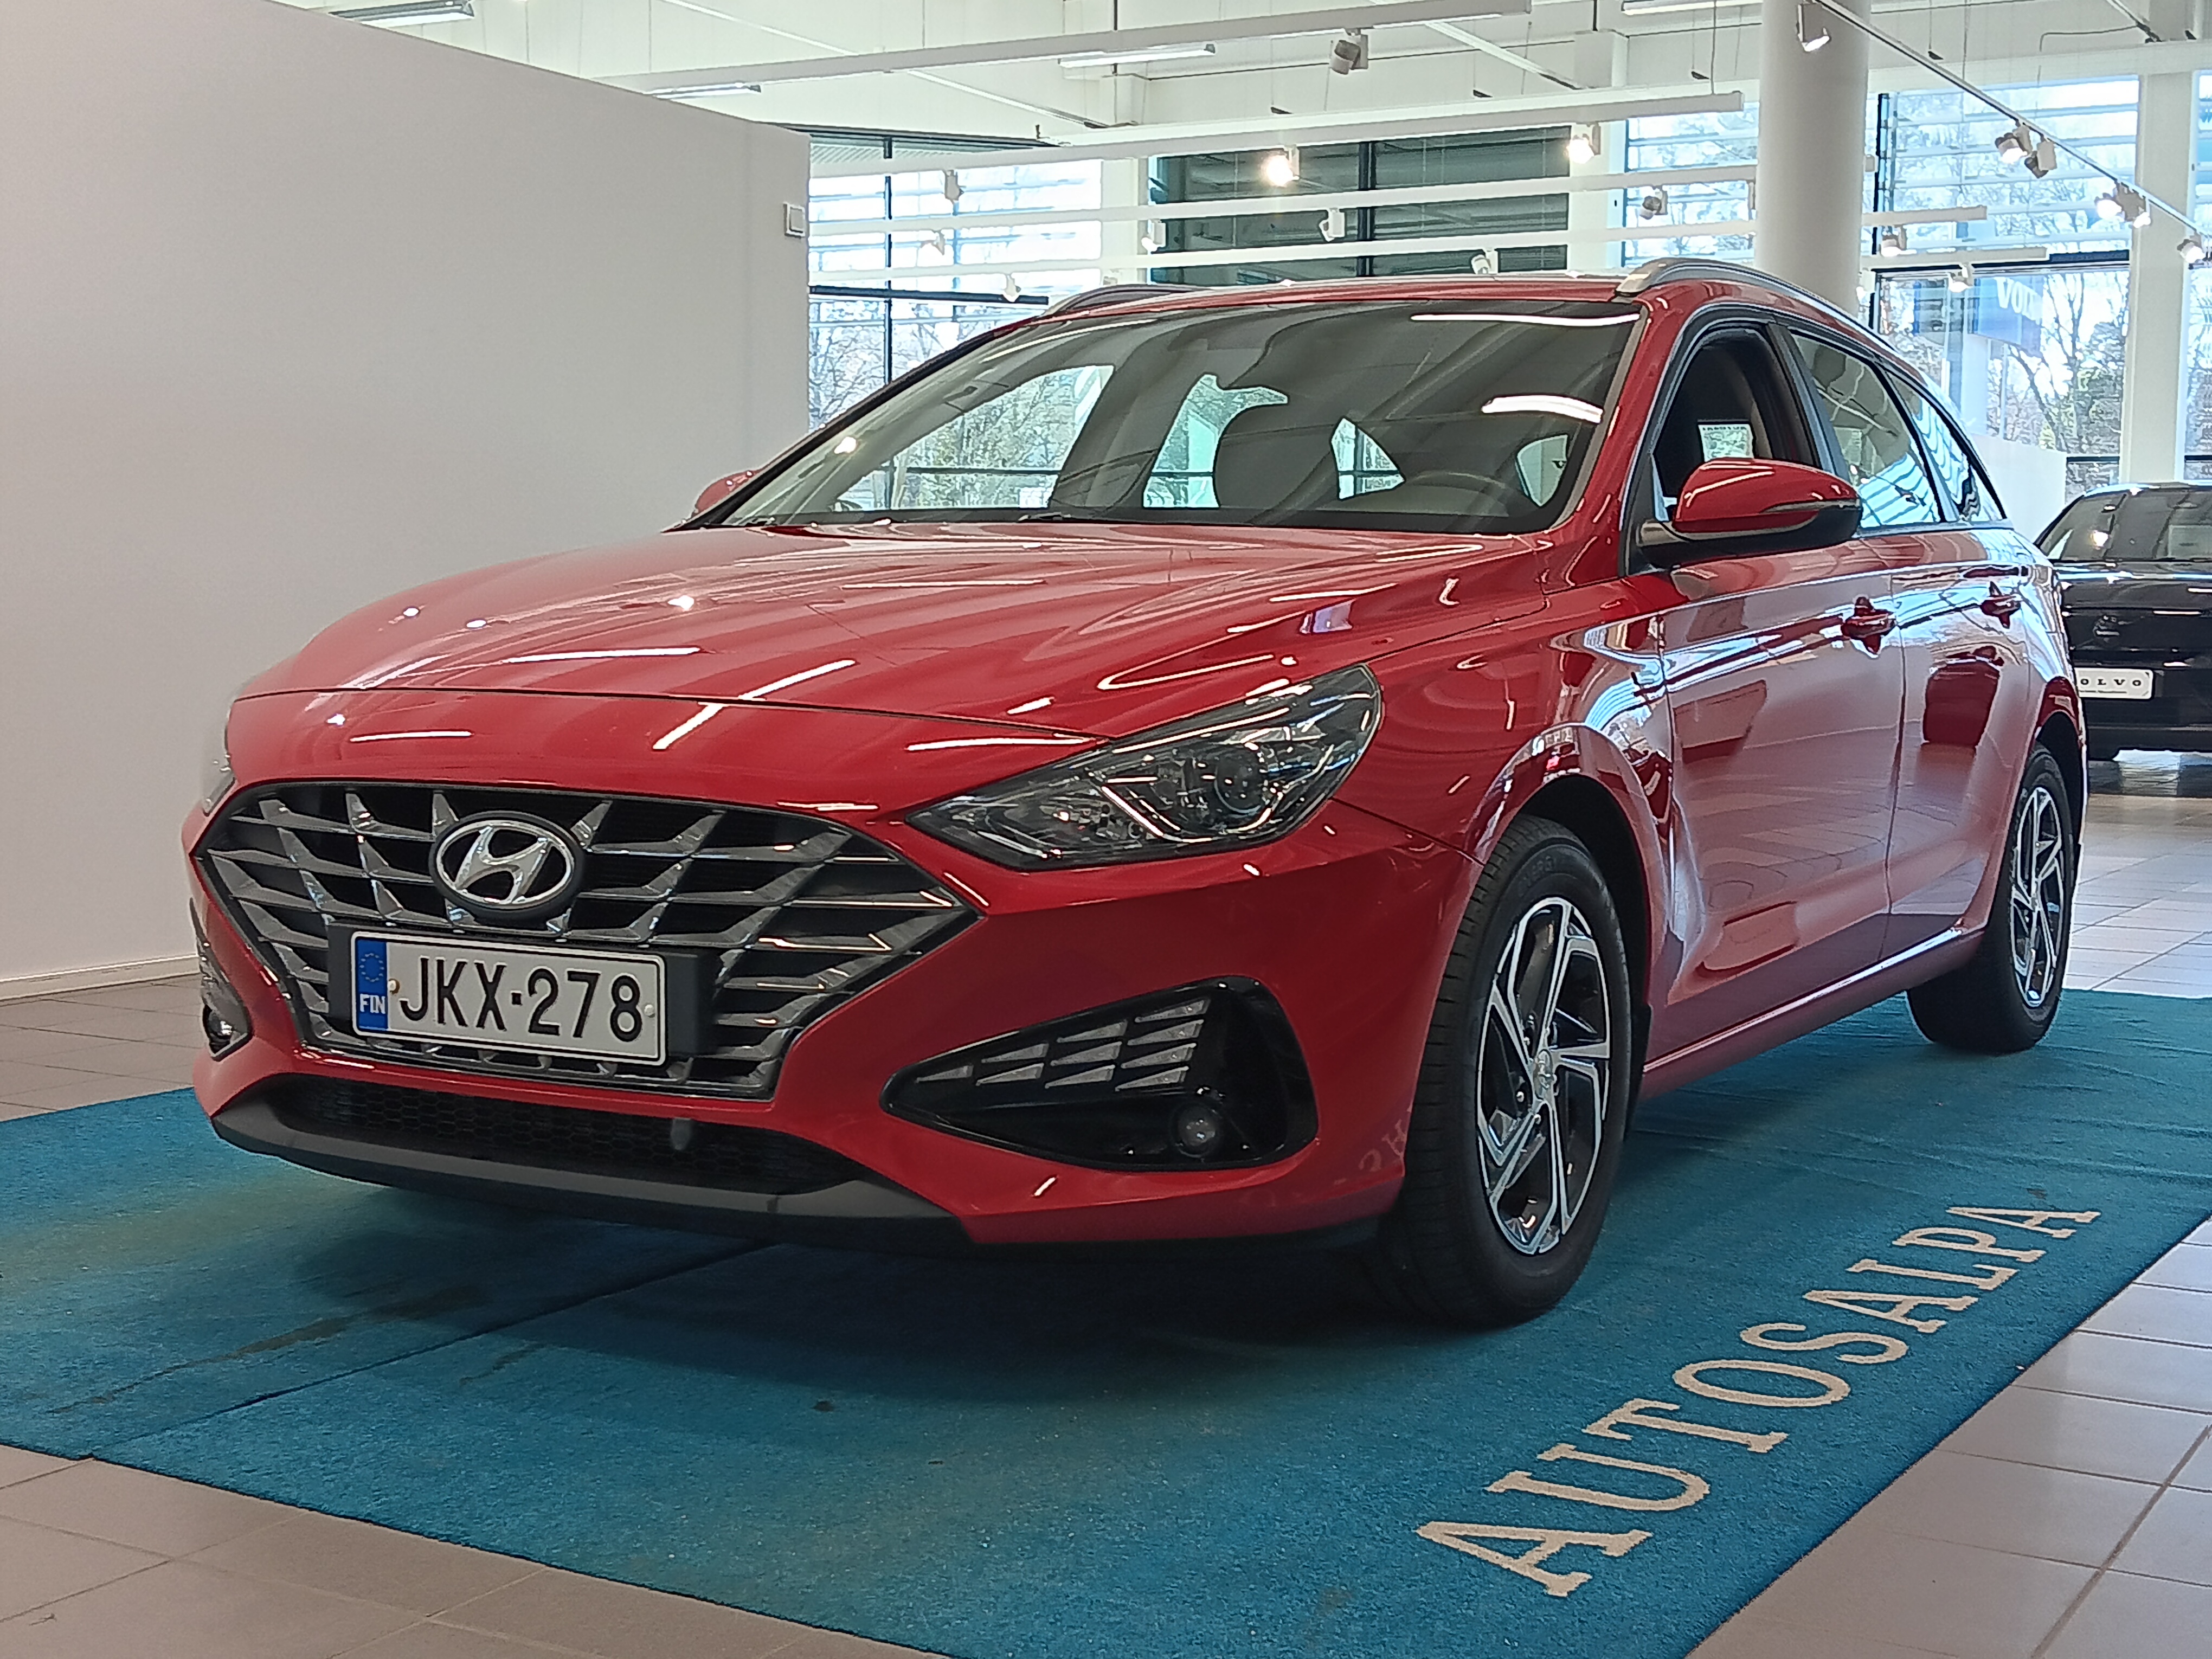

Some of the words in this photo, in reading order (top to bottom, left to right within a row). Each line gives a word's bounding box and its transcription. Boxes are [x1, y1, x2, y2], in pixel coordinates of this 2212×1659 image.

[2080, 678, 2142, 686] OLVO
[360, 994, 387, 1014] FIN
[1416, 1203, 2102, 1598] AUTOSALPA
